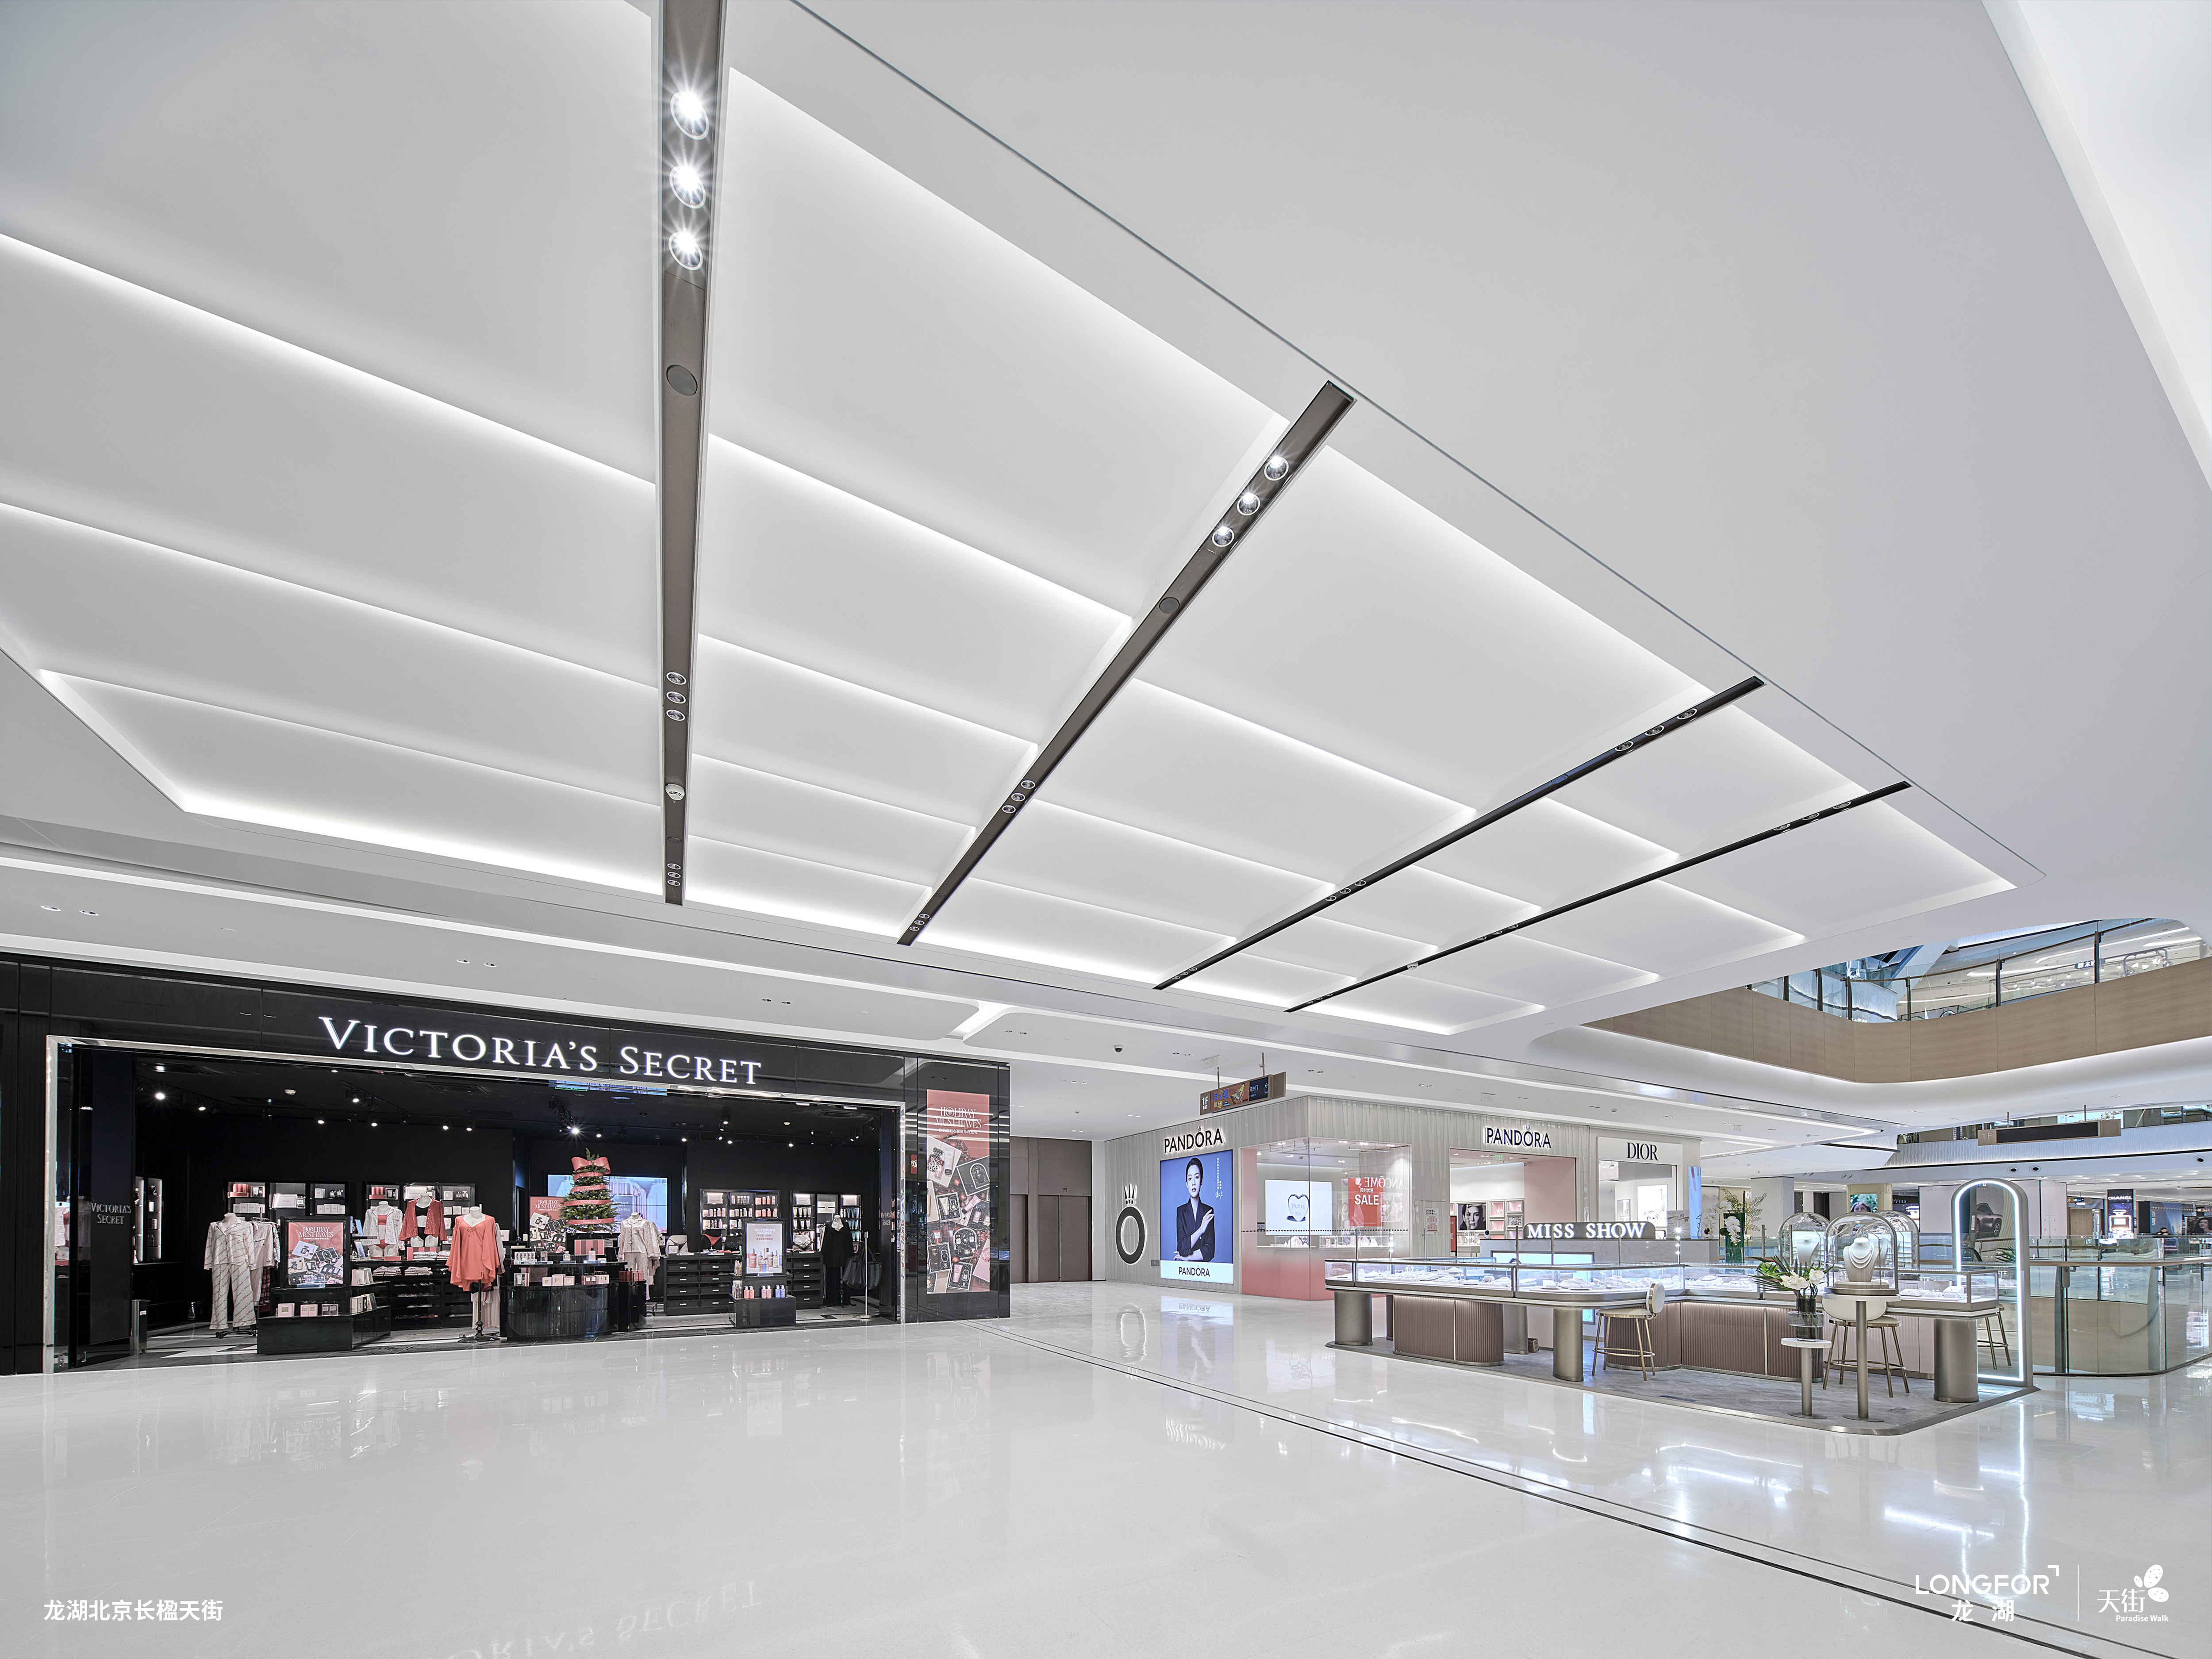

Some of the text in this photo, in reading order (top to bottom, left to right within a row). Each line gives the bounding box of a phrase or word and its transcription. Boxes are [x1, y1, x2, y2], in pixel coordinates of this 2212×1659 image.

[318, 1017, 761, 1085] VICTORIA'S SECRET
[1202, 1096, 1208, 1106] 1F
[940, 1106, 976, 1118] HOLIDAY
[935, 1117, 982, 1129] MUST-HAVES
[1164, 1128, 1224, 1153] PANDORA
[1486, 1127, 1551, 1148] PANDORA
[1626, 1142, 1659, 1161] DIOR
[1354, 1194, 1379, 1205] SALE
[91, 1202, 132, 1214] VICTORIA'S
[97, 1214, 125, 1225] SECRET
[1527, 1223, 1646, 1238] MISS SHOW
[1179, 1267, 1210, 1277] PANDORA
